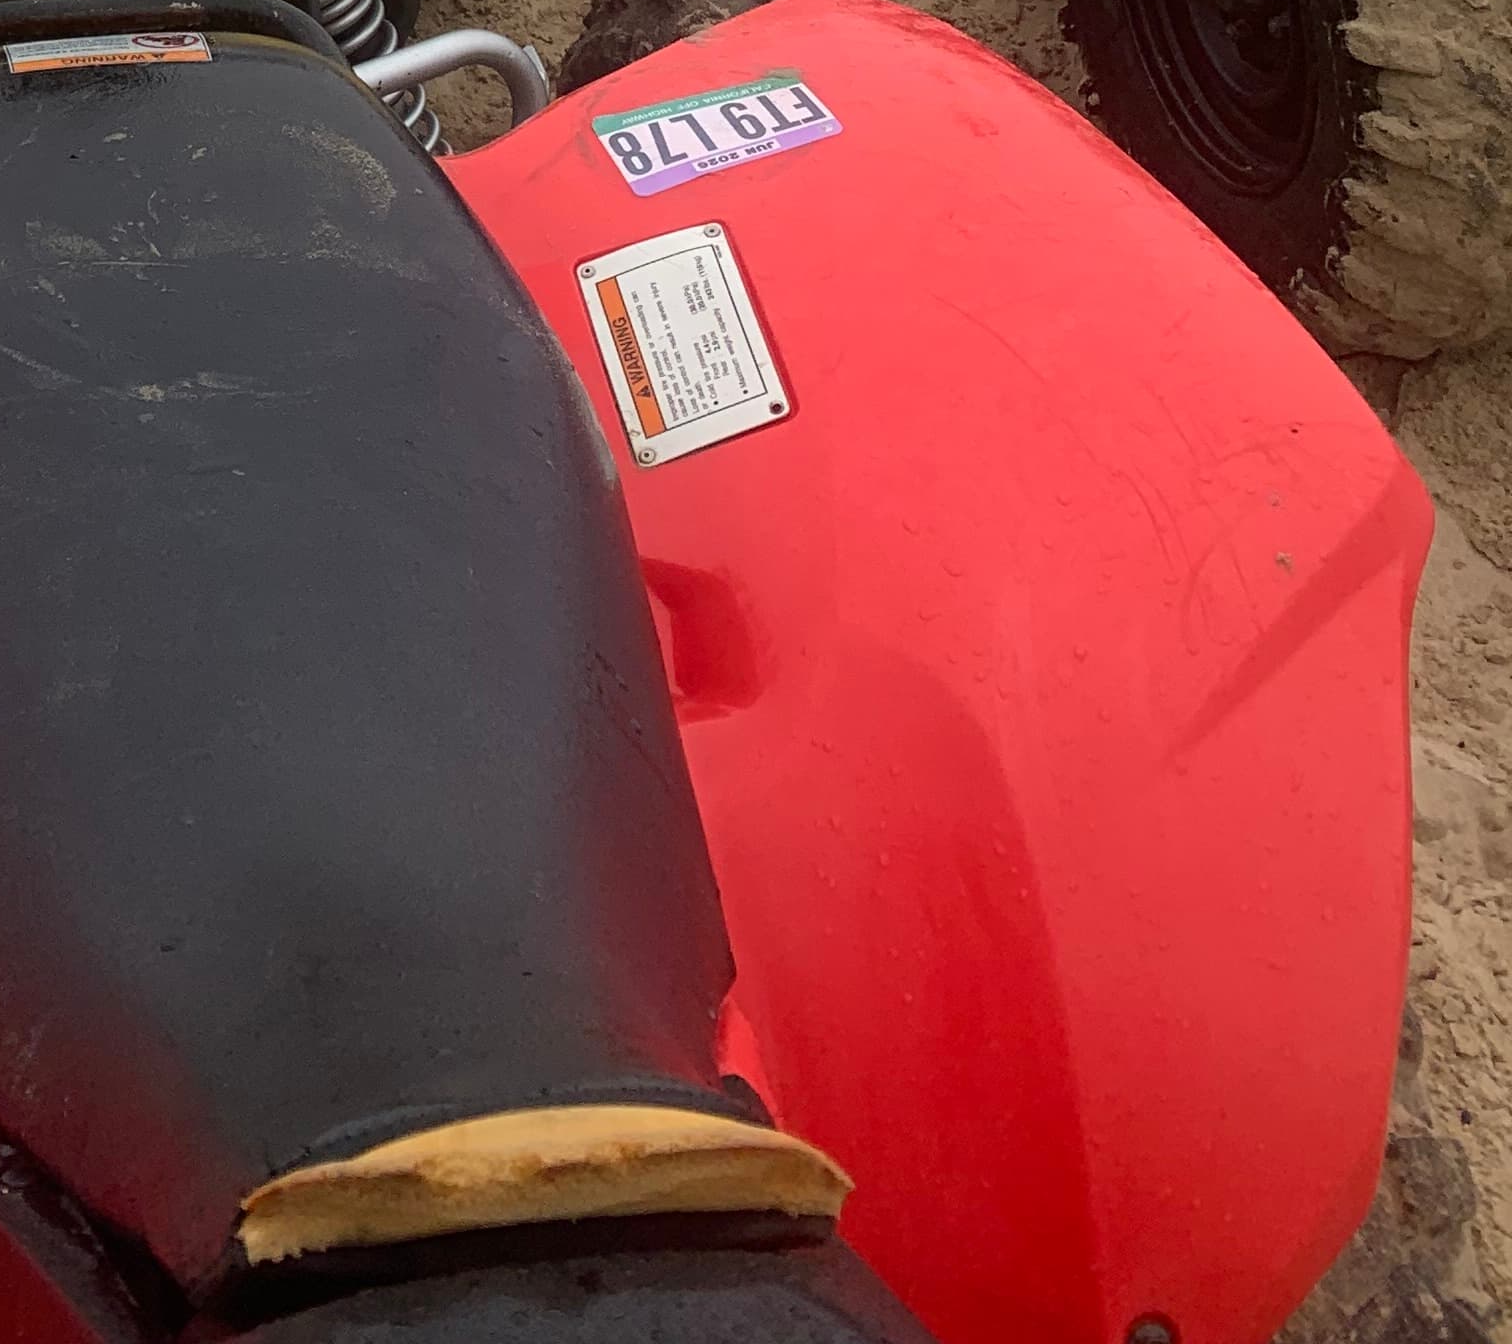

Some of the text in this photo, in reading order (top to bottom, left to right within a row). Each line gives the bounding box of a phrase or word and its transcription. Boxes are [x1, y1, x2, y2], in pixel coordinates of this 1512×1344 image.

[62, 53, 145, 65] WARNING
[703, 84, 771, 103] CALIFORNIA
[621, 107, 672, 125] HIGHWAY
[608, 87, 827, 176] FT9 L78
[746, 141, 775, 155] JUN
[612, 317, 644, 382] WARNING
